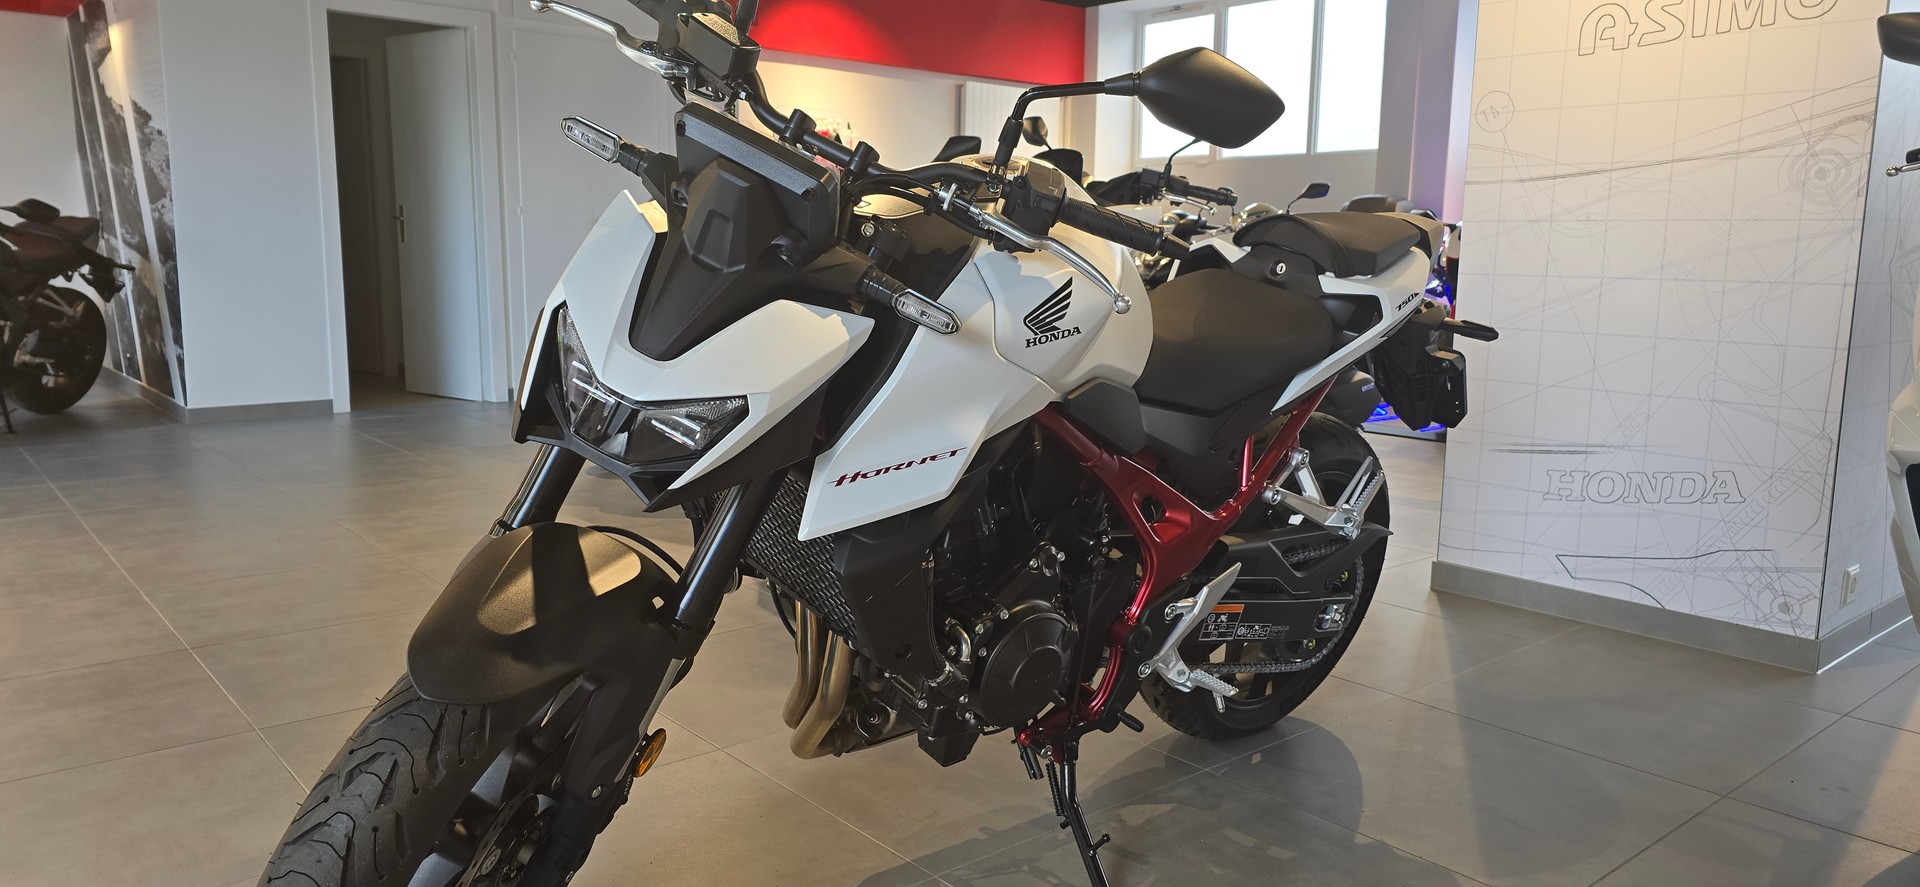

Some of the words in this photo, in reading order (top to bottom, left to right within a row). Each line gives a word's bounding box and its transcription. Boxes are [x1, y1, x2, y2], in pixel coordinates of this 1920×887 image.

[1395, 292, 1415, 313] 750
[1024, 326, 1082, 349] HONDA
[827, 446, 968, 488] HORNET
[1543, 469, 1746, 504] HONDA
